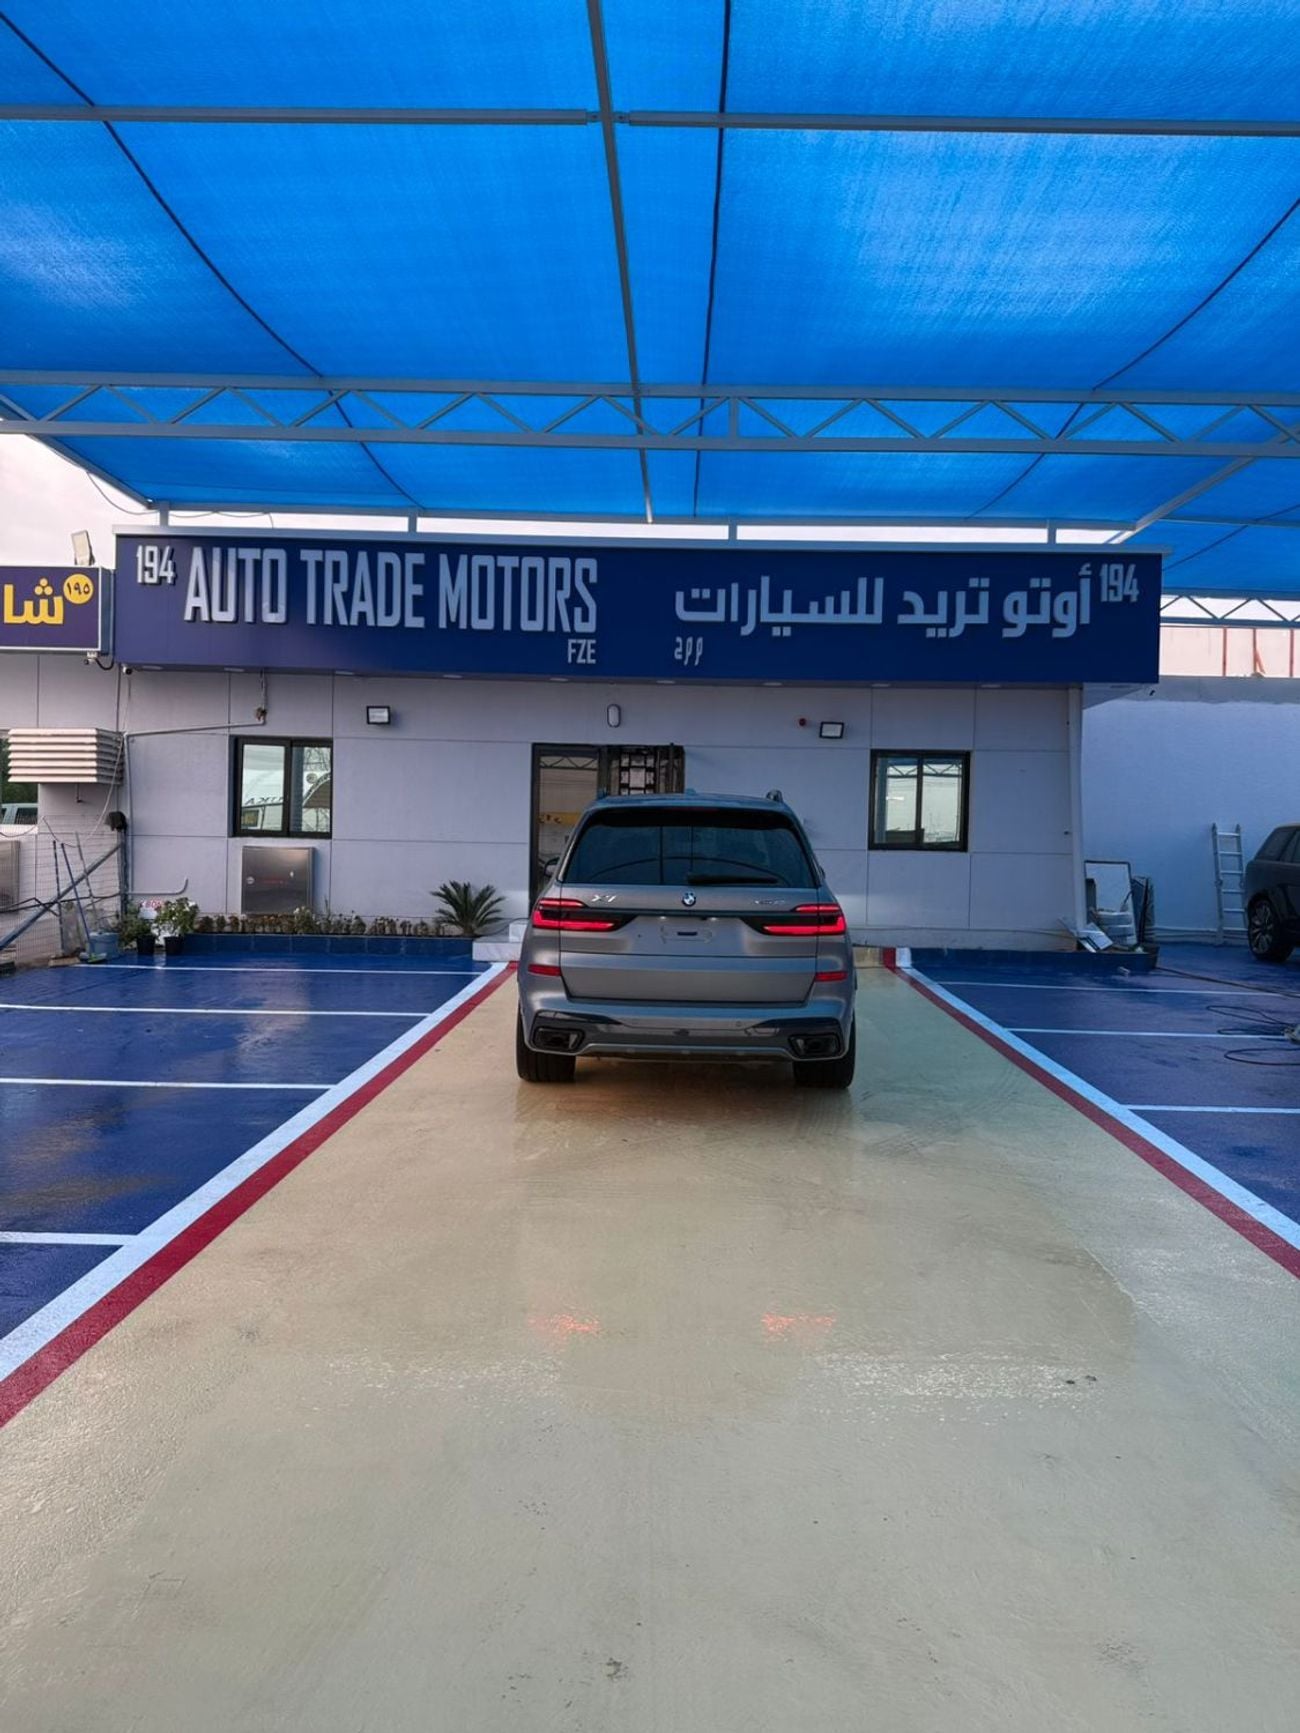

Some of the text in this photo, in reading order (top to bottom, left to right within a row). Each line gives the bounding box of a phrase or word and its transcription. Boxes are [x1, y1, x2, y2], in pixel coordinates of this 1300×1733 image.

[135, 544, 597, 632] 194 AUTO TRADE MOTORS
[674, 563, 1140, 638] 194 أوتو تريد للسيارات
[567, 639, 597, 663] FZE
